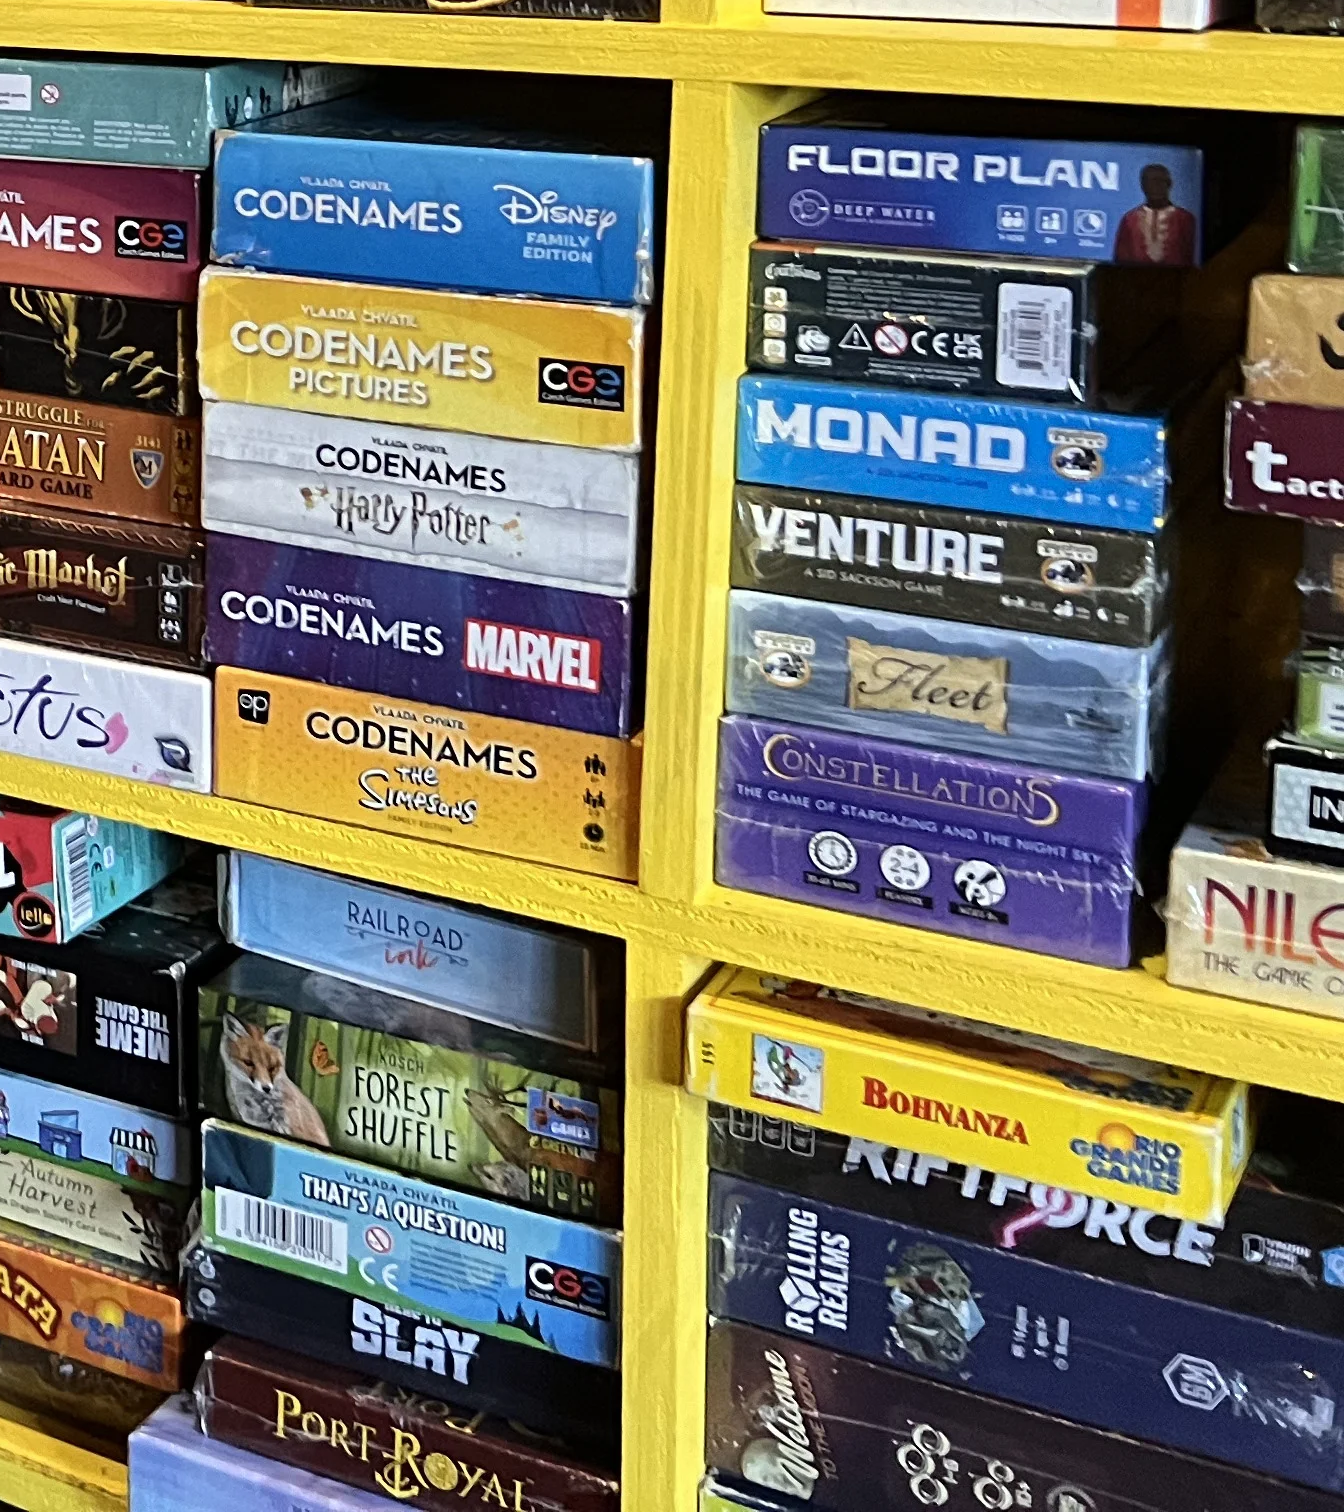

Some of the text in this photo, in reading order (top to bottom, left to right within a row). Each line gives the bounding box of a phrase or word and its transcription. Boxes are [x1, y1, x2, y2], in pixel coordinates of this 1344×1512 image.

[787, 143, 1119, 192] FLOOR PLAN
[233, 184, 618, 242] CODENAMES Disney
[525, 230, 590, 251] FAMILY
[521, 245, 593, 264] EDITION
[229, 319, 495, 382] CODENAMES
[289, 365, 428, 407] PICTURES
[753, 398, 1027, 475] MONAD
[40, 474, 94, 501] GAME
[315, 442, 507, 494] CODENAMES
[748, 501, 1004, 584] VENTURE
[220, 590, 598, 692] CODENAMES MARVEL
[856, 656, 997, 715] Fleet
[306, 710, 539, 782] CODENAMES
[762, 733, 1061, 828] CONSTELLATIONS
[736, 782, 1103, 866] THE GAME OF STARGAZING AND THE NIGHT SKY
[347, 899, 463, 953] RAILROAD
[1202, 951, 1311, 991] THE GAME
[354, 1065, 451, 1120] FOREST
[860, 1076, 1029, 1146] BOHNANZA
[345, 1106, 459, 1164] SHUFFLE
[301, 1171, 507, 1255] THAT'S A QUESTION!
[818, 1230, 851, 1331] REALMS
